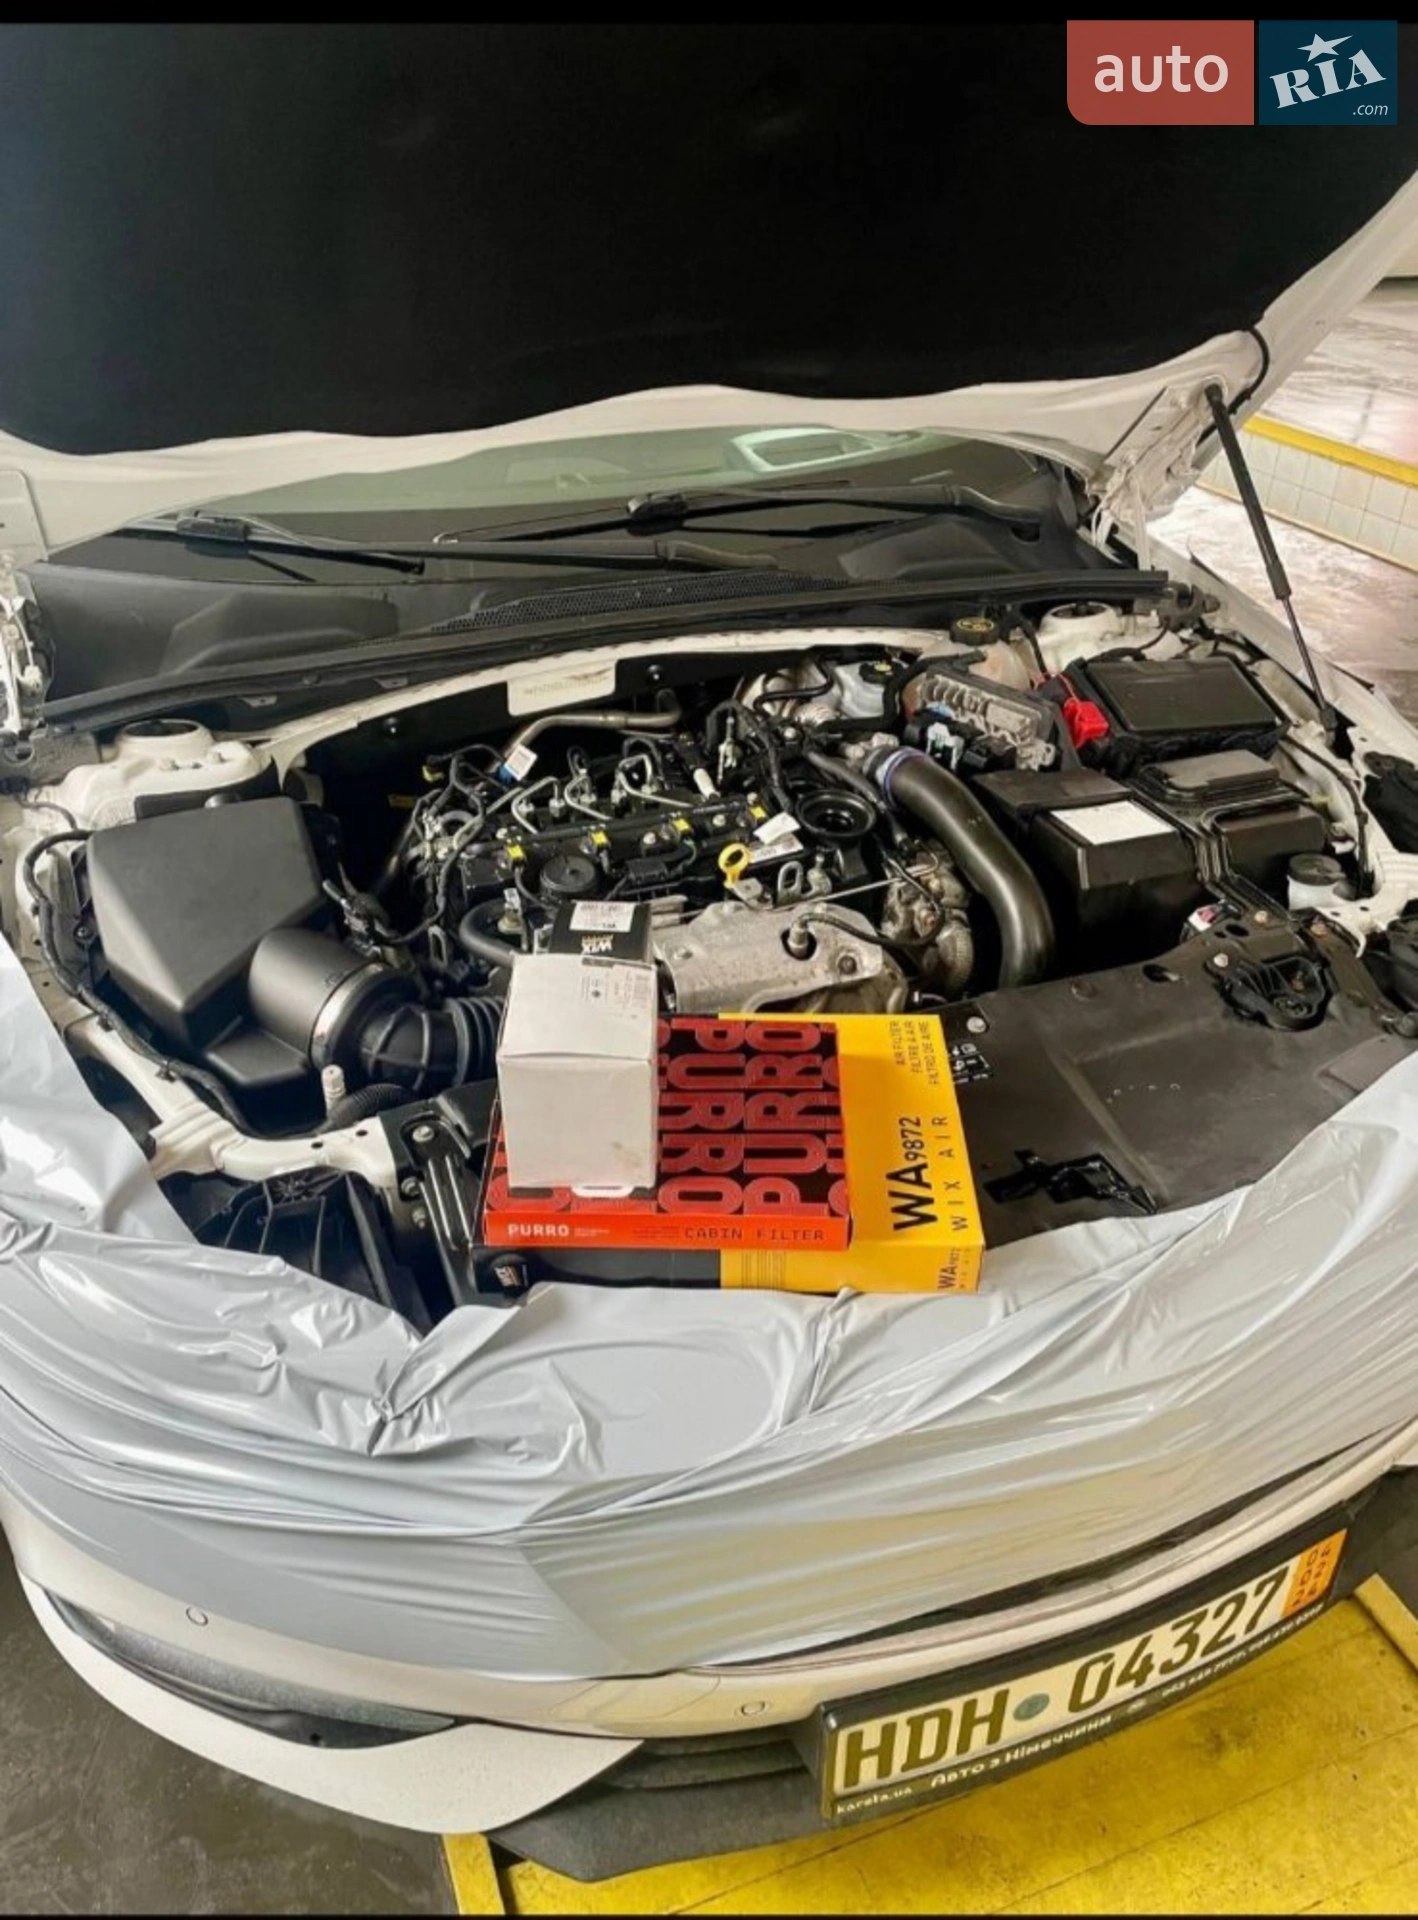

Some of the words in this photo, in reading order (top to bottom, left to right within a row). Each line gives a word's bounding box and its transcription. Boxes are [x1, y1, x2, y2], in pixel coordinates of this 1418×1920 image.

[744, 1022, 829, 1215] PURRO
[931, 1116, 955, 1158] AIR
[885, 1116, 939, 1231] WA9872
[507, 1223, 570, 1237] PURRO
[943, 1181, 969, 1231] WIX
[684, 1227, 743, 1240] CABIN
[756, 1229, 825, 1241] FILTER
[843, 1687, 1009, 1788] HDH
[1067, 1566, 1289, 1713] 04327
